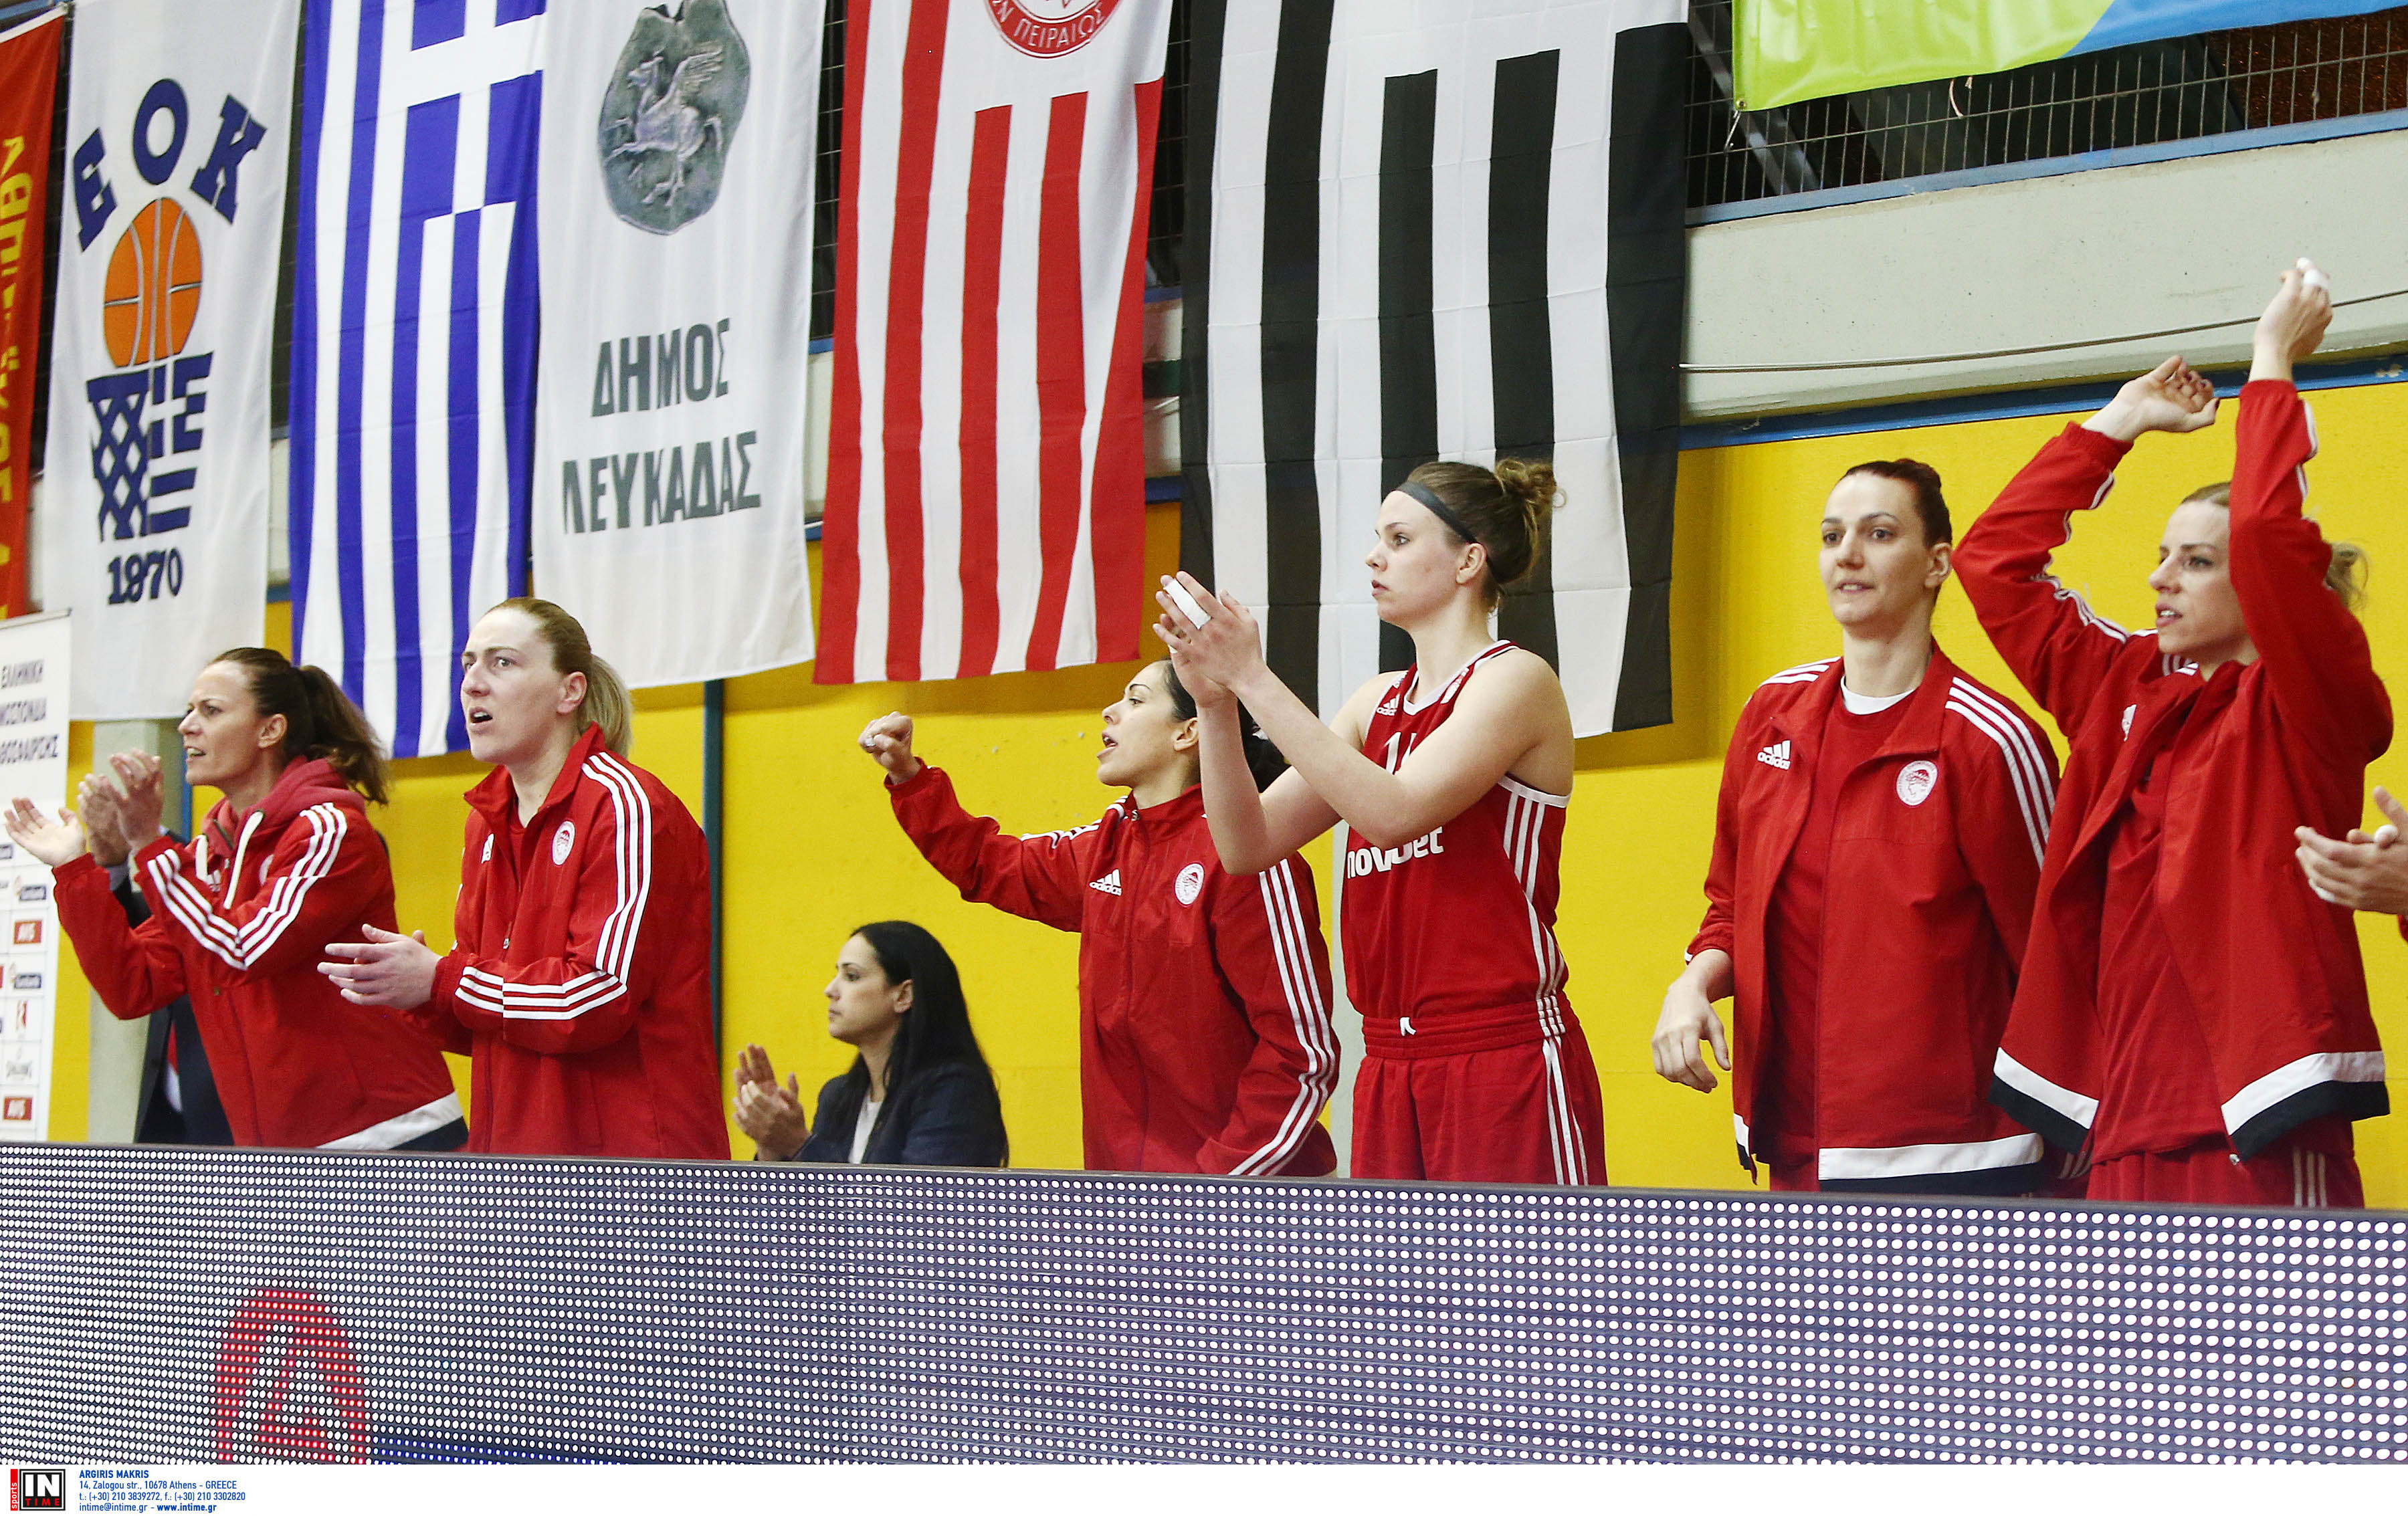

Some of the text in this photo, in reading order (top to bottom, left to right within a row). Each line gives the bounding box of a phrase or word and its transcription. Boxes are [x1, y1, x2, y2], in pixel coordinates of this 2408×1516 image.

[1013, 2, 1106, 48] ΠΕΙΡΑΙΩΣ
[591, 317, 730, 417] ΔΗΜΟΣ
[561, 430, 762, 535] ΛΕΥΚΑΔΑΣ
[108, 546, 184, 606] 1970
